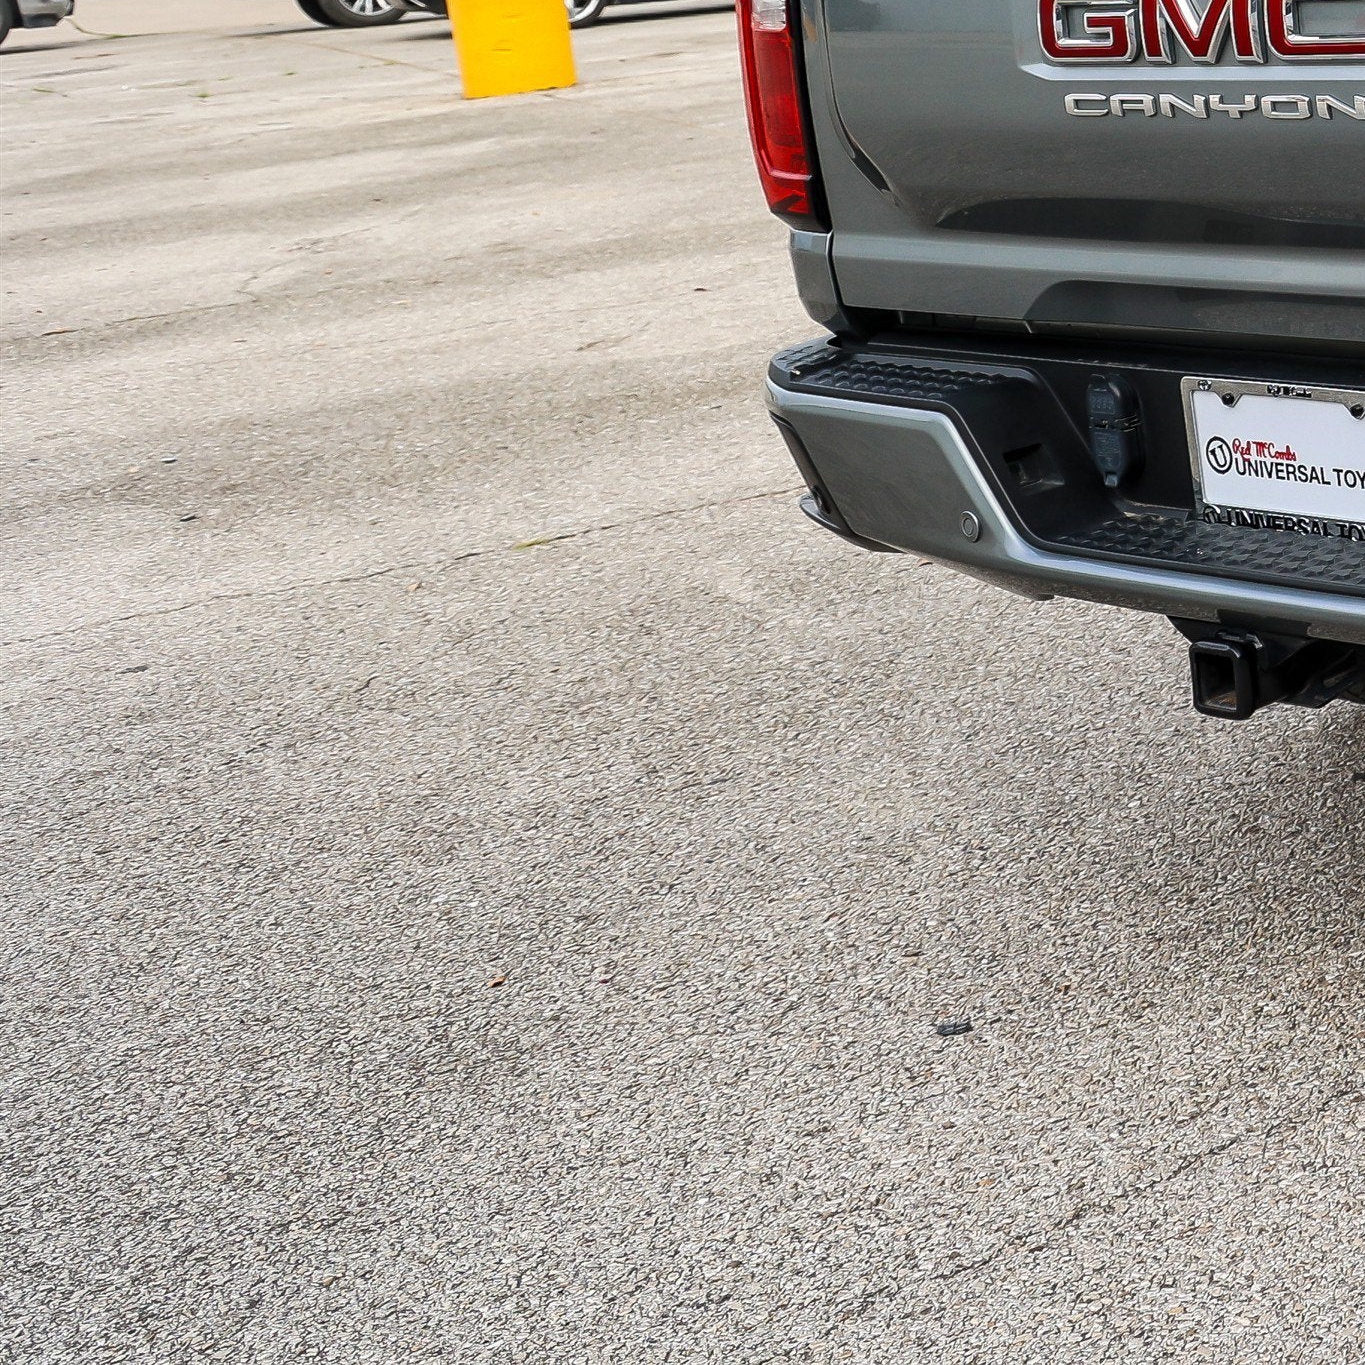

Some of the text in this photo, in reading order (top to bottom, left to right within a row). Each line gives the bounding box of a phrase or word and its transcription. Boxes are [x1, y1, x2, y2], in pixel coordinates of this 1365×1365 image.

[1232, 438, 1298, 462] Red McCombs
[1234, 457, 1332, 486] UNIVERSAL
